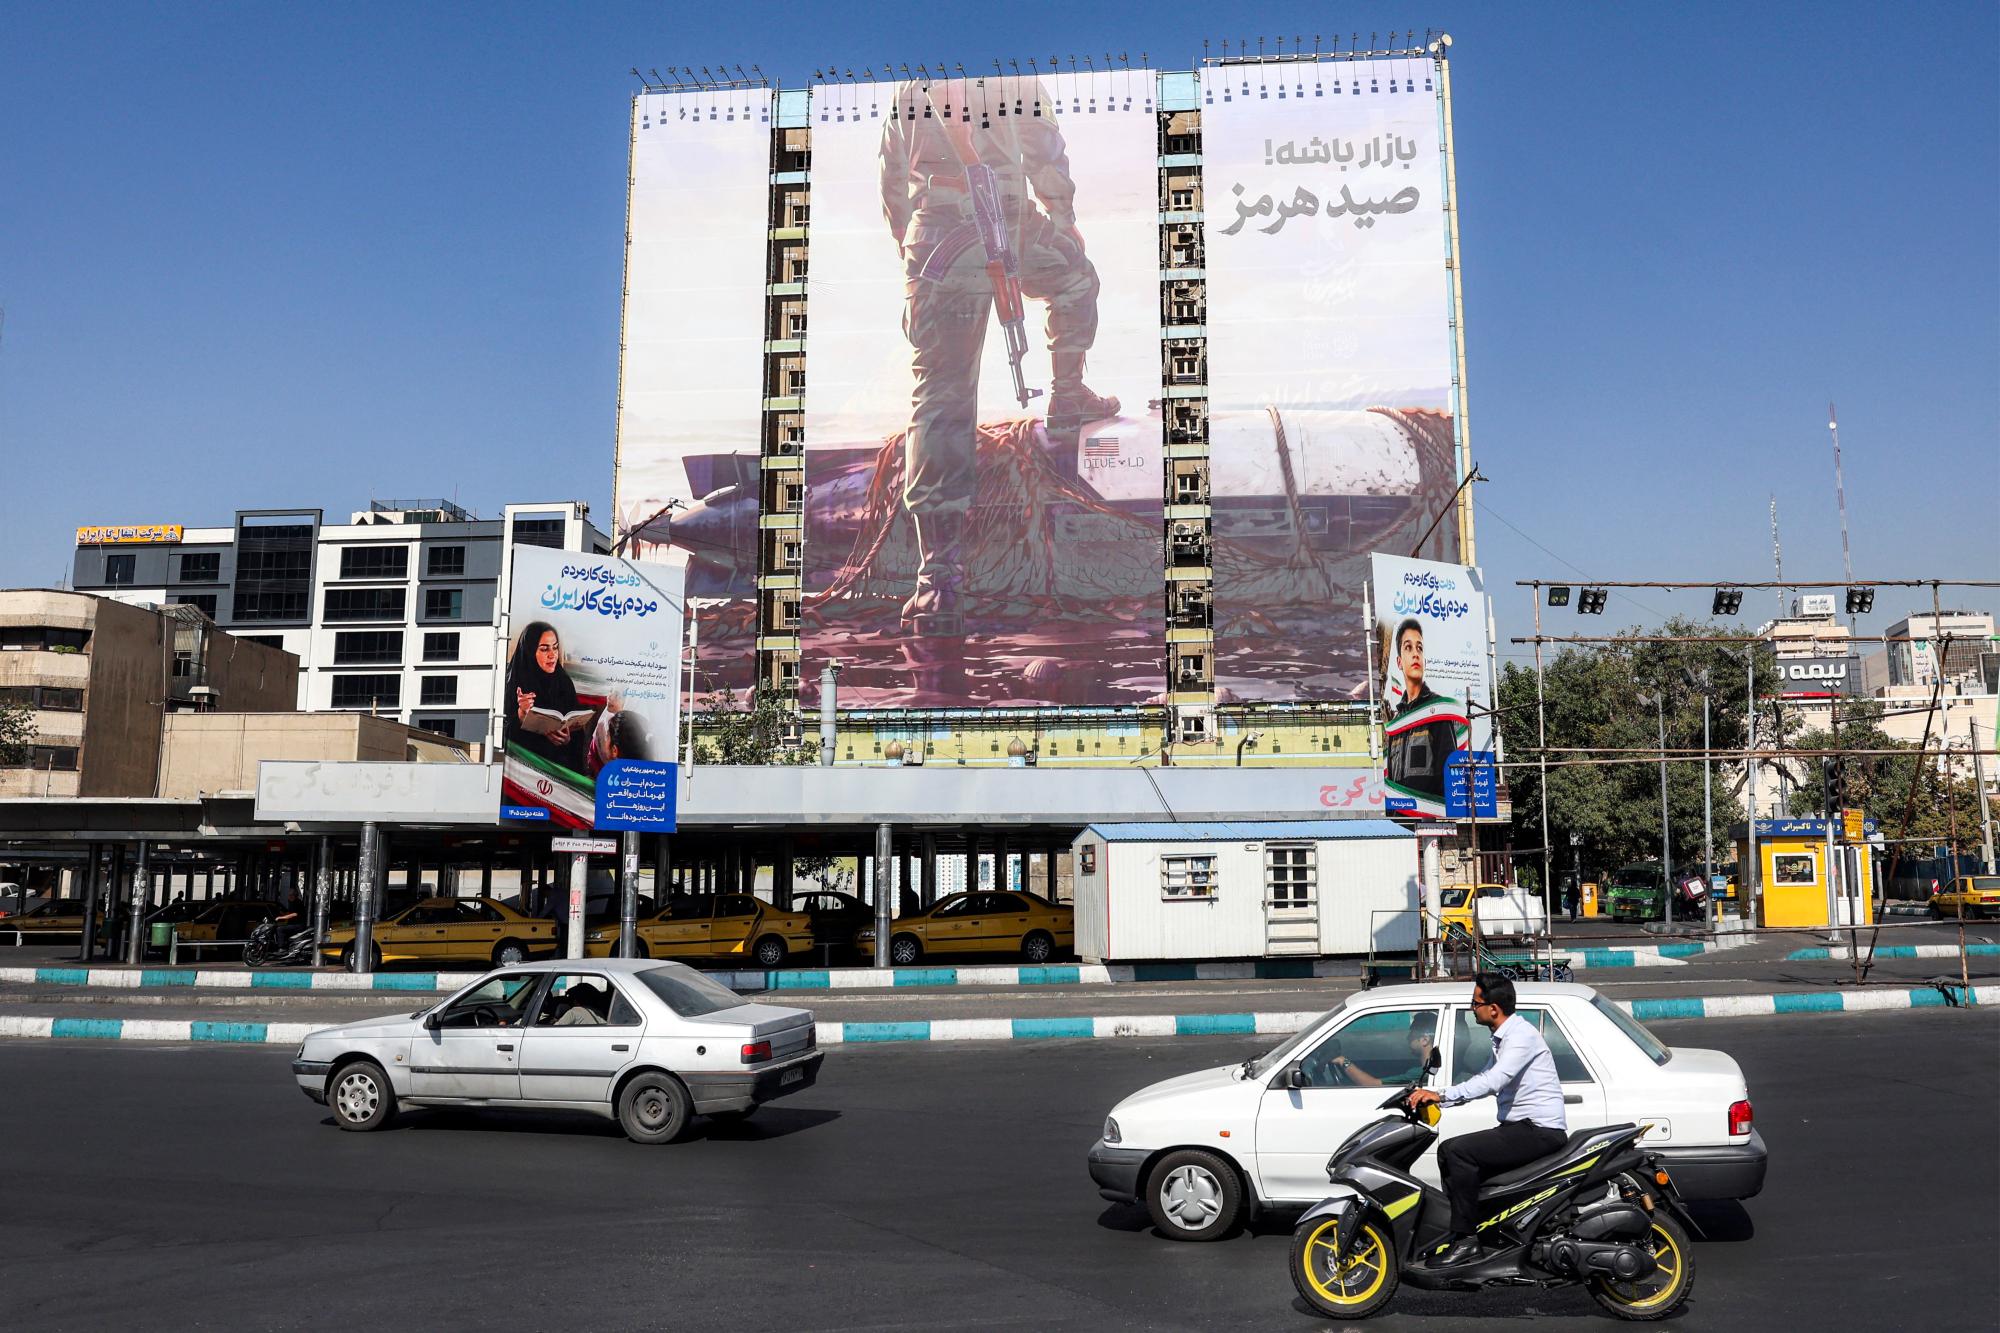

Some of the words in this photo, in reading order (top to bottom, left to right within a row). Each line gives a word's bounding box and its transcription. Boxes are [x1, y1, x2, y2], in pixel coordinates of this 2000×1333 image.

[1265, 137, 1354, 171] باشه!
[1358, 133, 1417, 169] بازار
[1218, 183, 1320, 236] هرمز
[1327, 184, 1420, 229] صید
[561, 565, 586, 579] مردم
[582, 565, 603, 581] کار
[598, 570, 615, 586] پای
[616, 574, 640, 586] دولت
[1404, 572, 1420, 585] مردم
[1418, 571, 1430, 586] کار
[1429, 576, 1439, 591] پای
[1440, 579, 1455, 590] دولت
[541, 585, 577, 611] ایران
[574, 586, 606, 611] کار
[598, 594, 622, 619] پای
[623, 597, 657, 616] مردم
[1392, 592, 1416, 615] ایران
[1415, 592, 1434, 614] کار
[1431, 597, 1446, 621] پای
[1447, 600, 1468, 617] مردم
[1790, 664, 1846, 687] بیمه
[1320, 776, 1366, 807] کرج
[1781, 822, 1811, 832] تاکسیرانی
